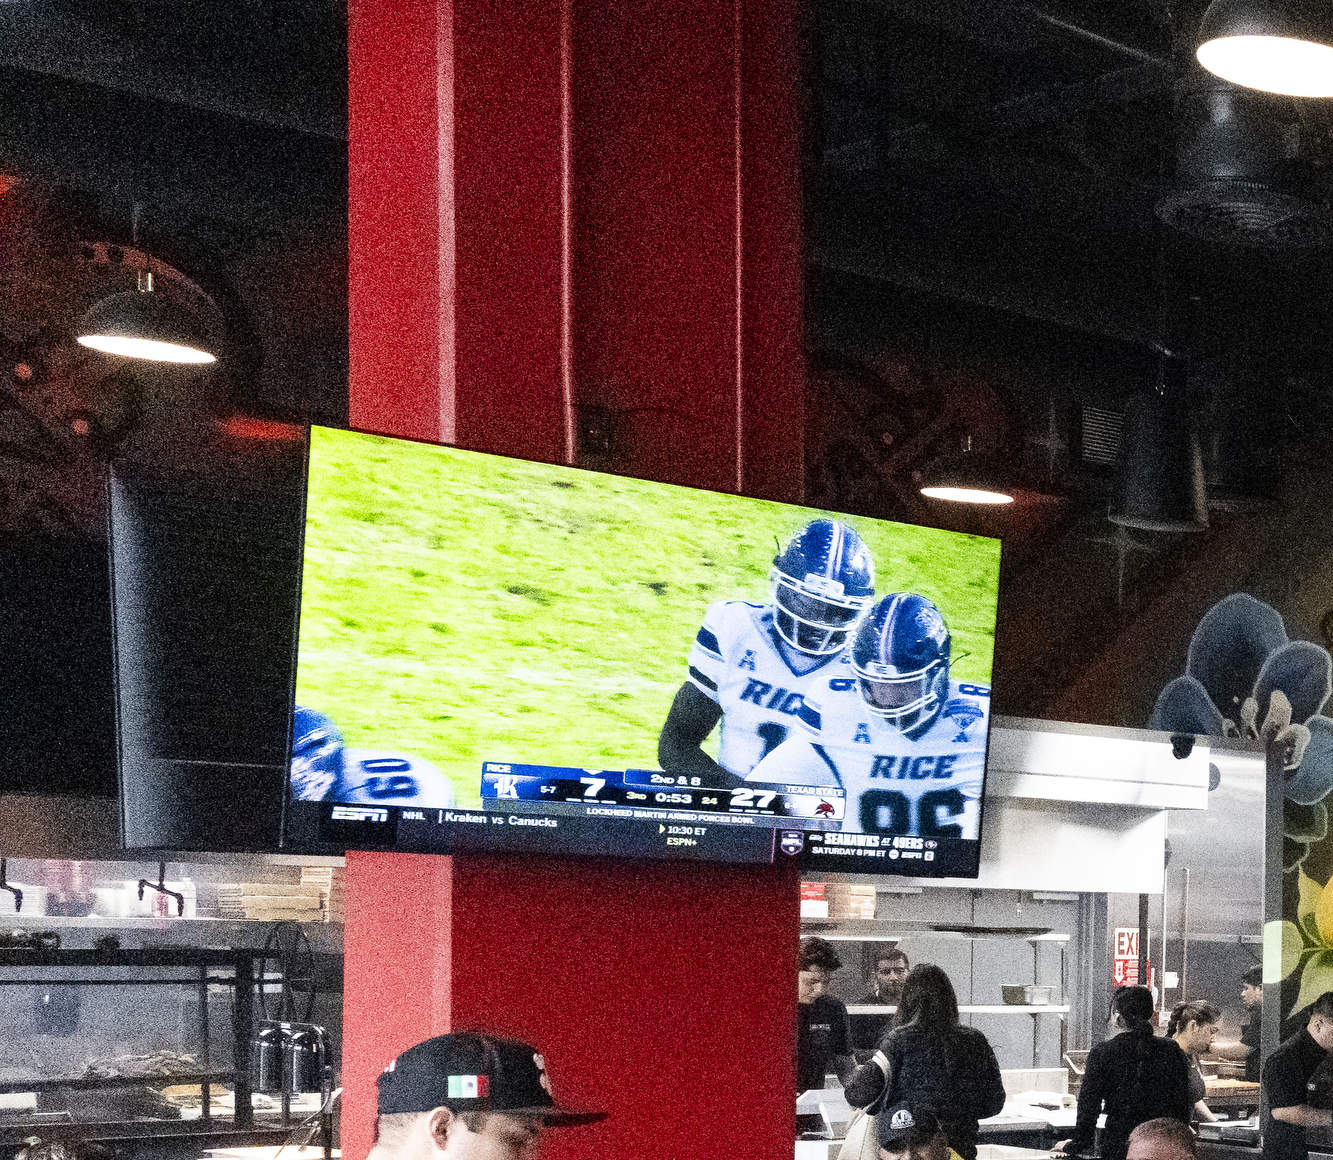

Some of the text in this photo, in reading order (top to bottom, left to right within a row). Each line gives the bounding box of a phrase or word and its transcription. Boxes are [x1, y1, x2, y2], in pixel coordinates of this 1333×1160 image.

[486, 763, 512, 774] RICE
[870, 754, 958, 780] RICE
[650, 773, 702, 786] 2ND & 8
[579, 777, 606, 798] 7
[786, 785, 844, 797] TEXAS STATE
[655, 792, 693, 804] 0:53
[701, 796, 718, 806] 24
[729, 787, 779, 809] 27
[331, 805, 389, 823] ESPN
[402, 811, 558, 828] NHL Kraken vs Canucks
[586, 807, 633, 818] LOCKHEED
[634, 810, 667, 820] MARTIN
[667, 825, 707, 836] 10:30 ET
[666, 836, 698, 846] ESPN+
[824, 833, 880, 848] SEAHAWKS
[892, 837, 924, 850] 49ERS
[812, 847, 857, 857] SATURDAY
